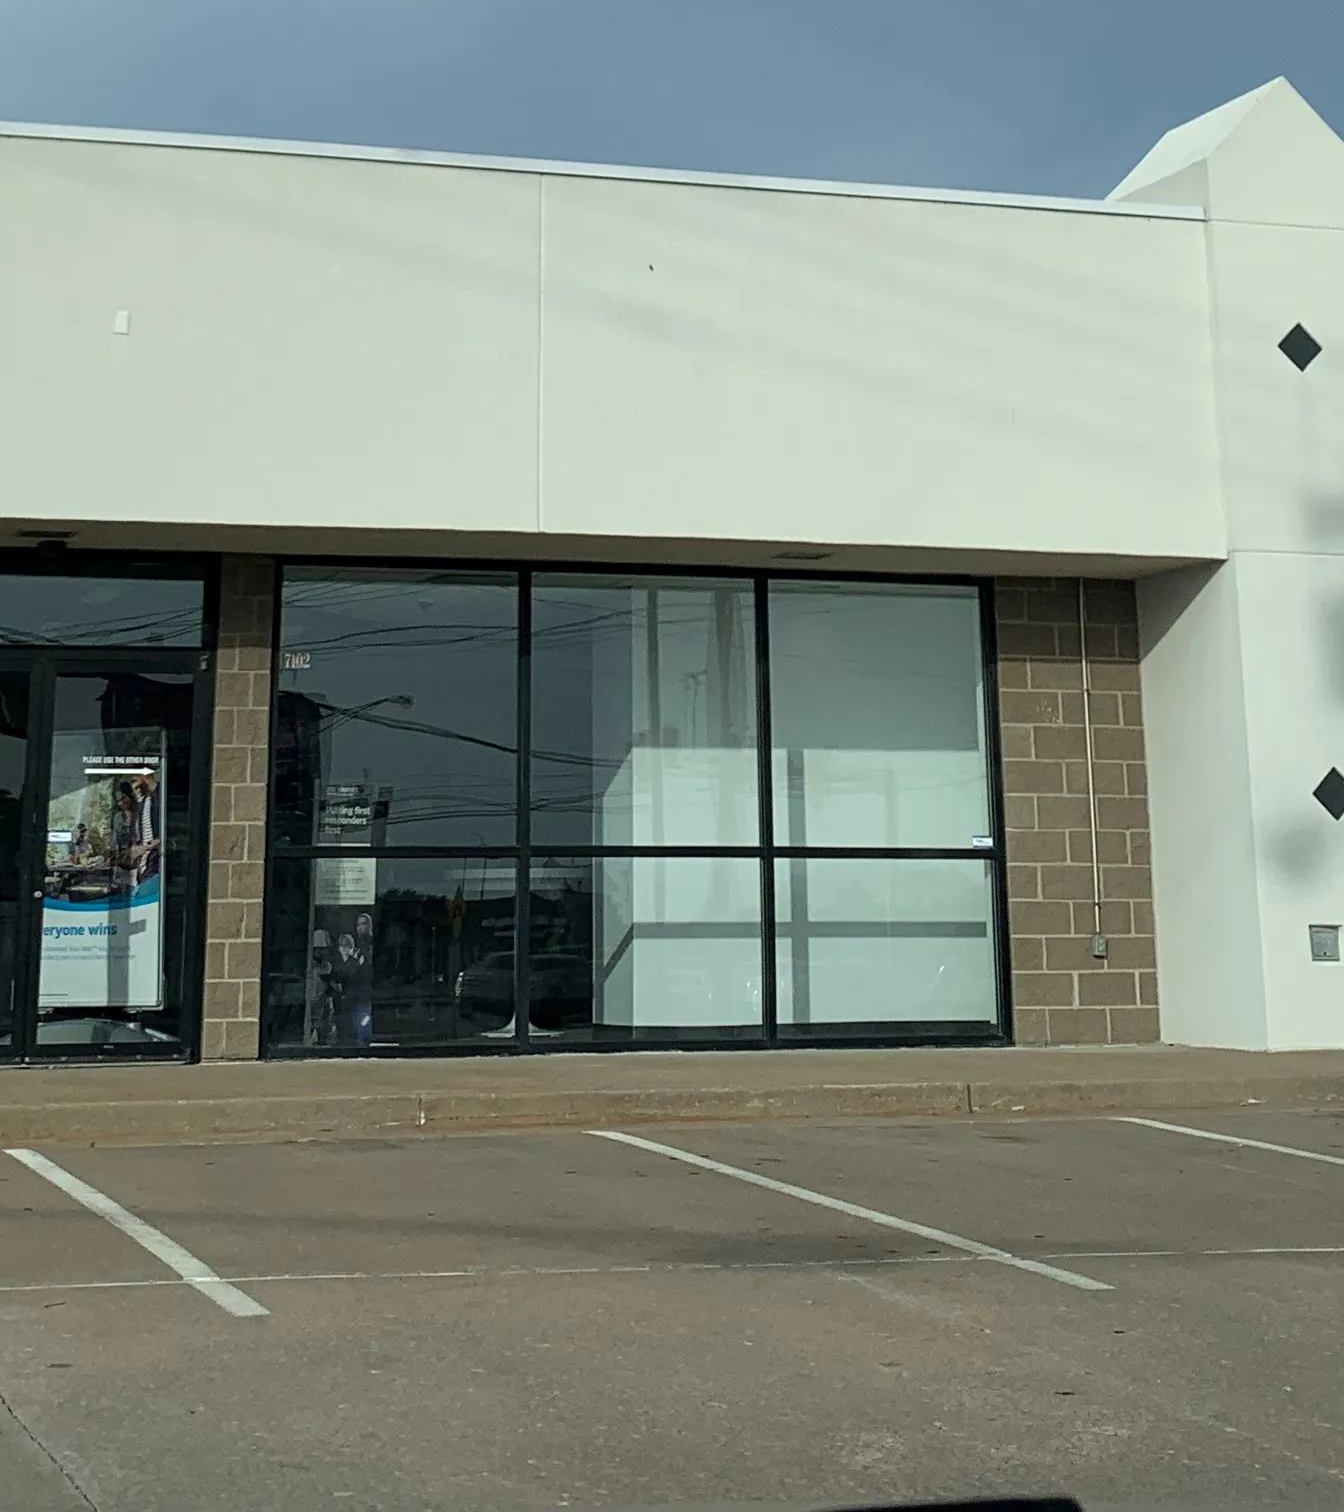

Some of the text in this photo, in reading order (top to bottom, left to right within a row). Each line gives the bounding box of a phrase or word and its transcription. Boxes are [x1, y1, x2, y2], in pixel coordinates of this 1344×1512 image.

[284, 652, 311, 668] 7102
[43, 922, 118, 939] eryone wins
